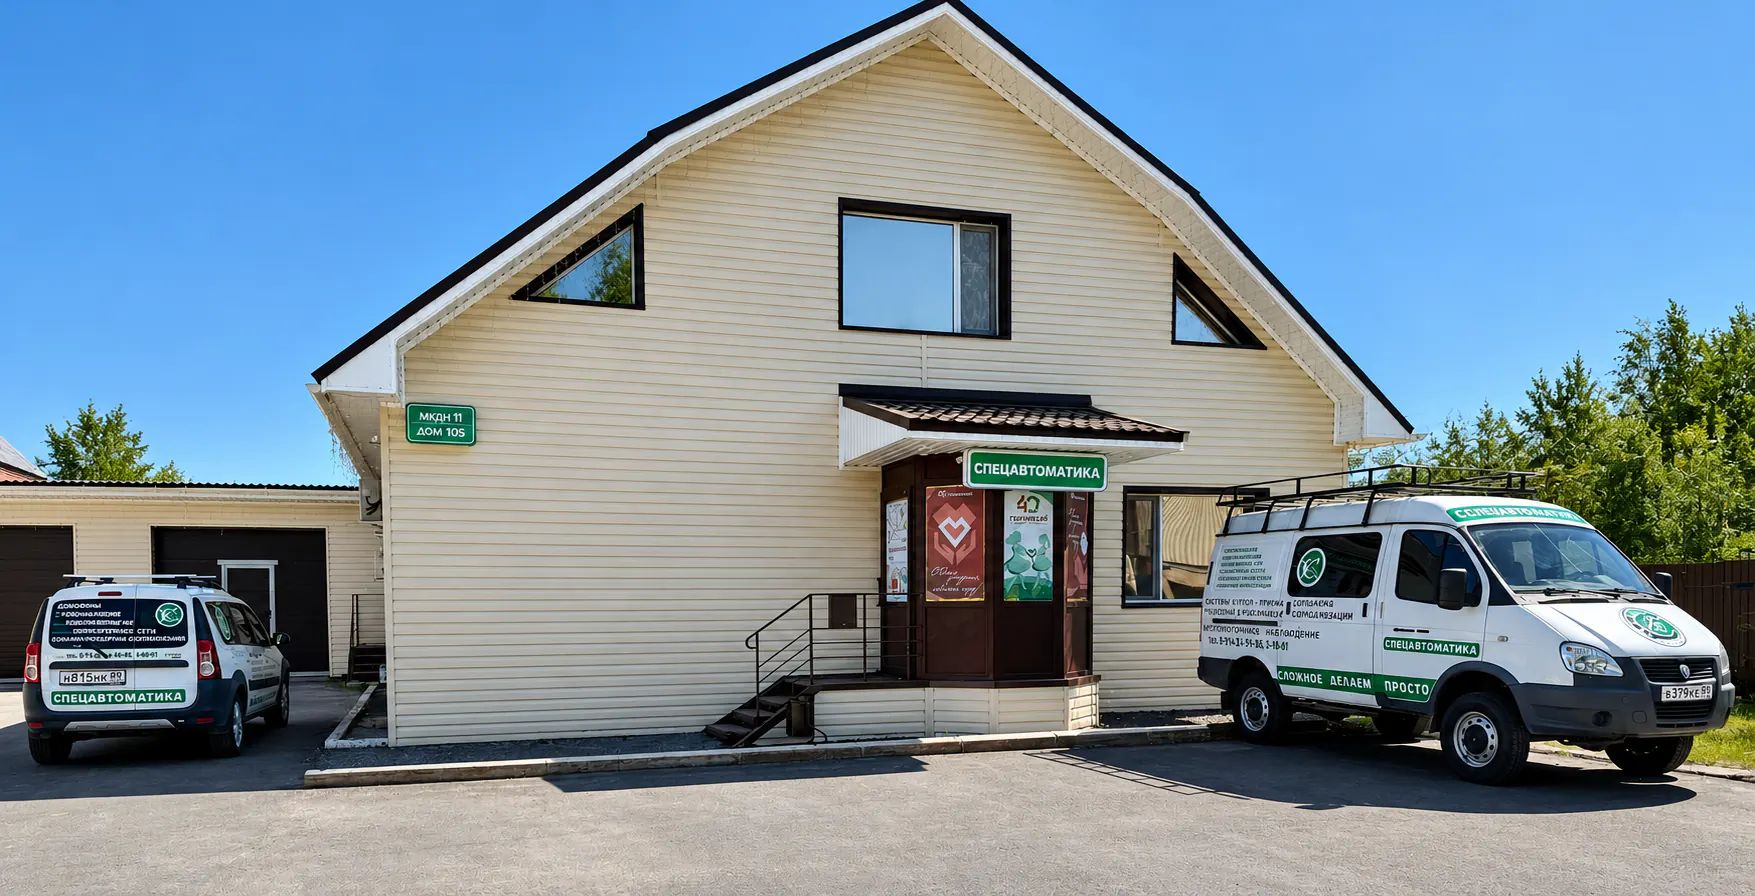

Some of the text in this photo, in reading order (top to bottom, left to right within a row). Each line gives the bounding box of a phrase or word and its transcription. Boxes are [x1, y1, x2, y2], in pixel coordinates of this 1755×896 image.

[453, 412, 463, 423] 11
[416, 427, 443, 437] ДОМ
[974, 462, 1100, 479] СПЕЦАВТОМАТИКА
[1385, 639, 1477, 655] СПЕЦАВТОМАТИКА
[1278, 670, 1429, 695] СЛОЖНОЕ ДЕЛАЕМ ПРОСТО
[53, 691, 183, 704] СПЕЦАВТОМАТИКА
